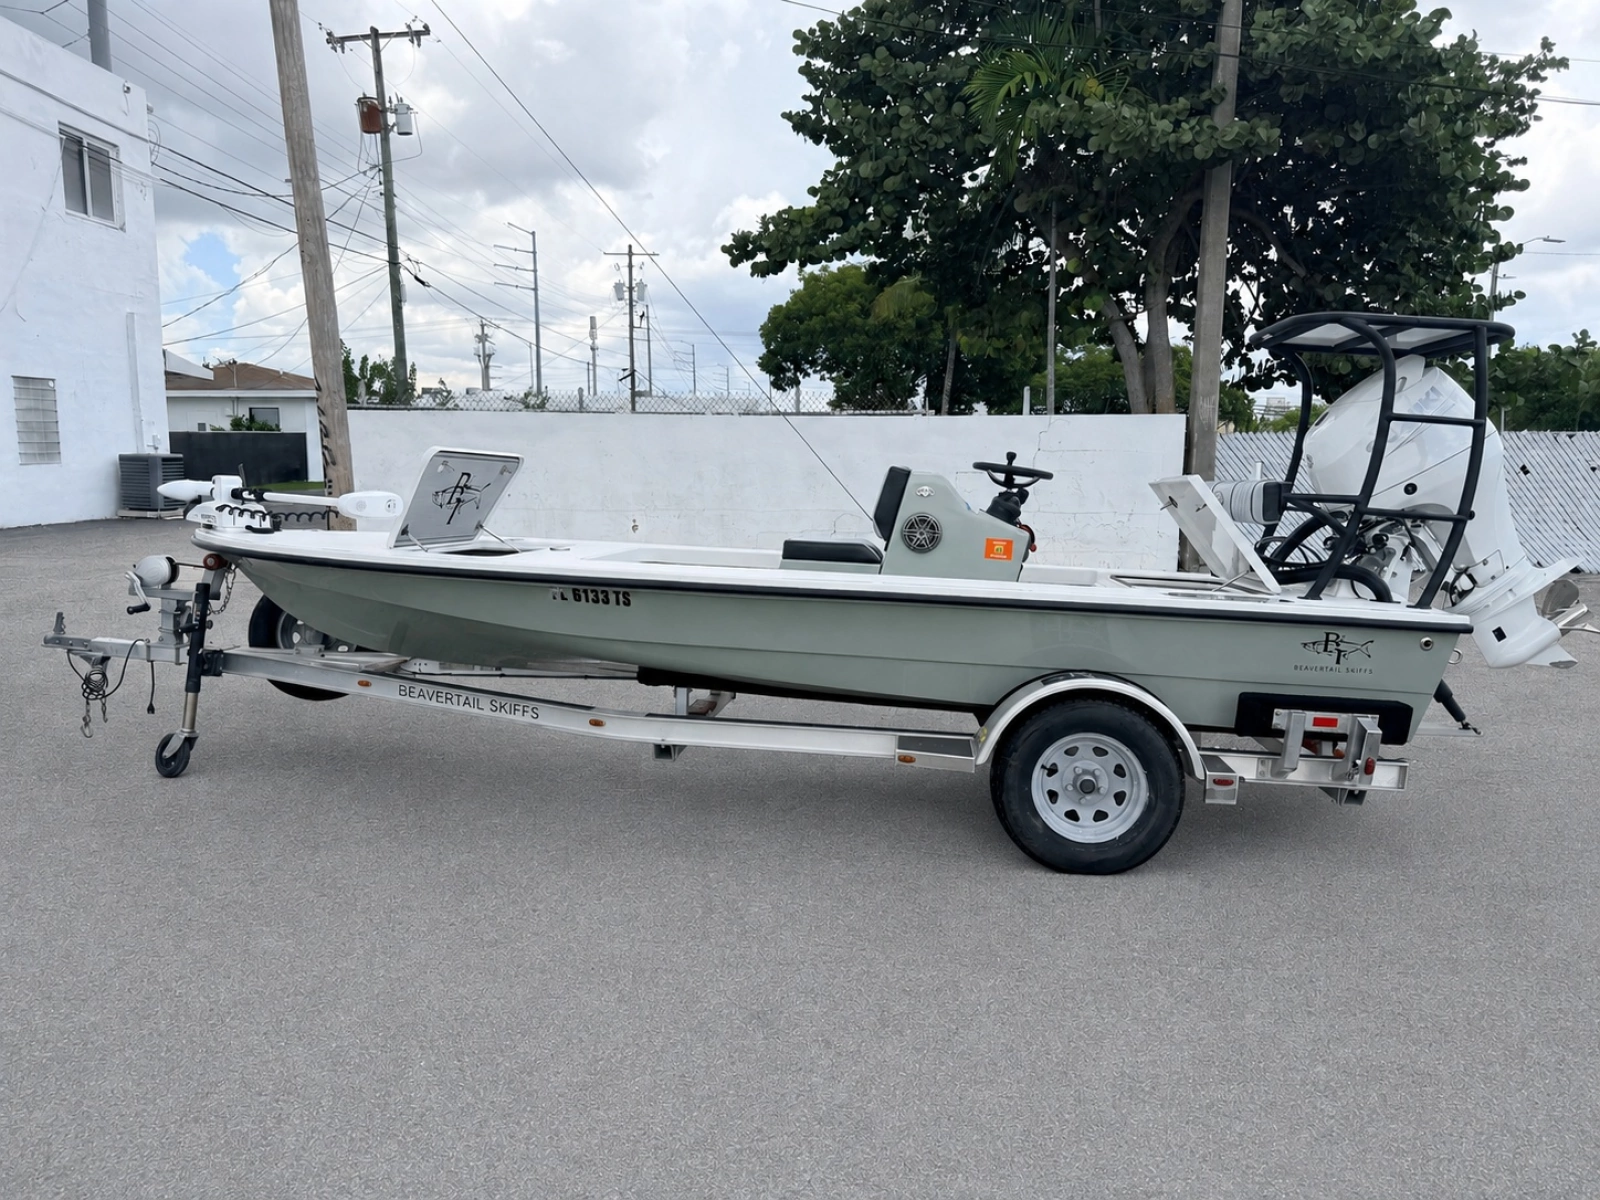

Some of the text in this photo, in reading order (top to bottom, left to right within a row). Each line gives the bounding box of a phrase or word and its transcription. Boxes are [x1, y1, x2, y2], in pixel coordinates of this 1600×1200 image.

[572, 587, 610, 605] 6133
[612, 590, 631, 607] TS
[1293, 664, 1373, 675] BEAVERTAIL SKIFFS
[398, 684, 540, 720] BEAVERTAIL SKIFFS
